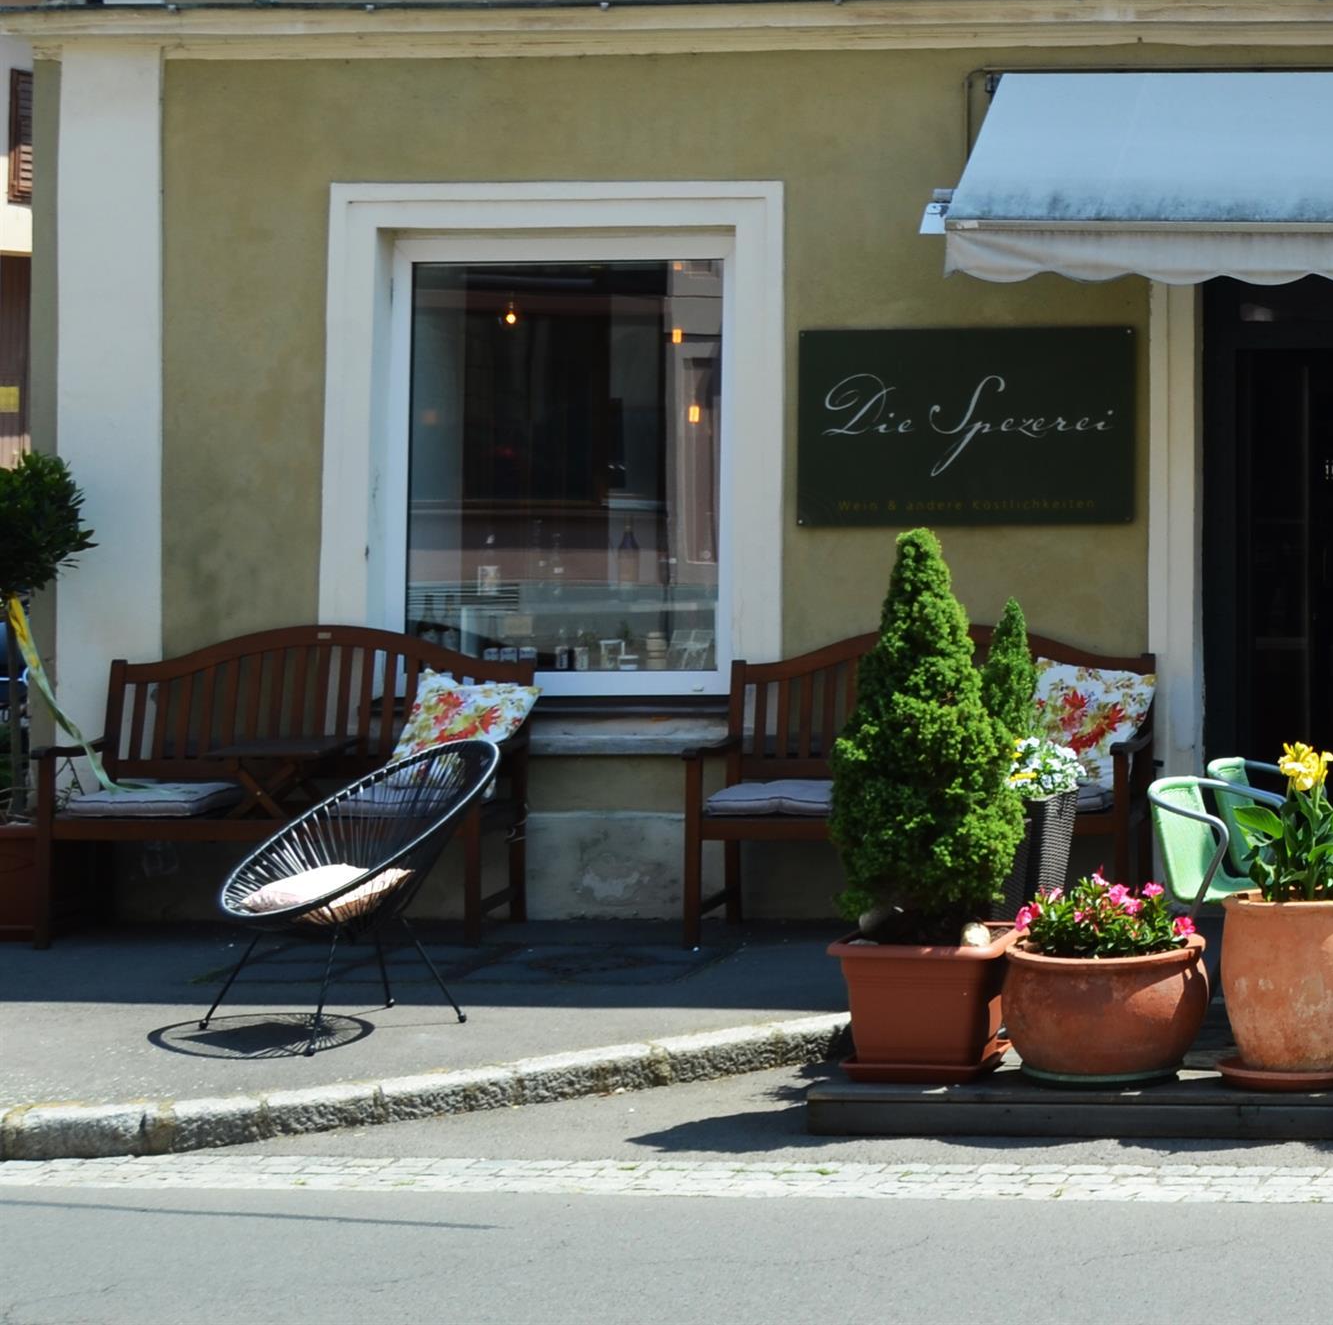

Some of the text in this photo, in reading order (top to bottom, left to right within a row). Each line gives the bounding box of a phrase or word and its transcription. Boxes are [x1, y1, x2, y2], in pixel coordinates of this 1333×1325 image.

[821, 373, 1114, 477] Die Spezerei
[838, 500, 879, 511] Wein
[905, 499, 963, 511] andere
